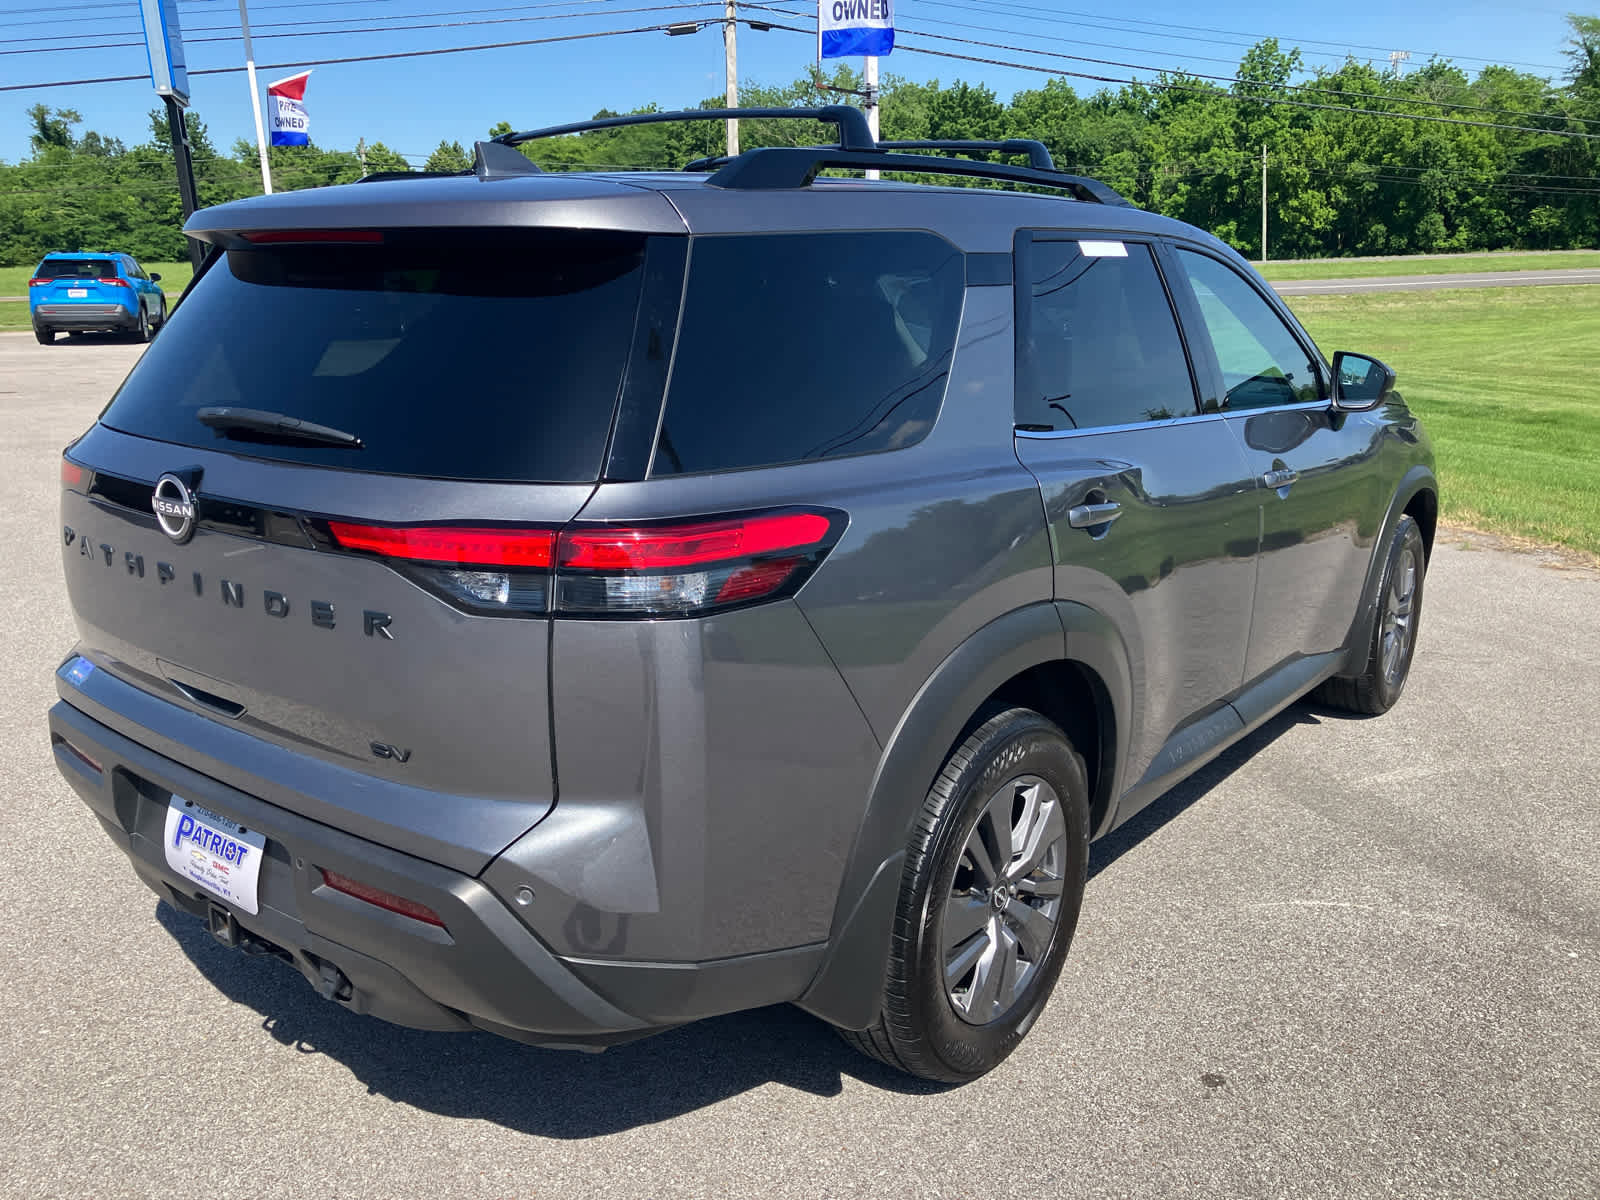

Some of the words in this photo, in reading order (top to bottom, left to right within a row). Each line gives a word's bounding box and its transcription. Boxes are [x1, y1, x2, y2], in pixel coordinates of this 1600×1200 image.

[832, 0, 889, 21] OWNED
[279, 100, 296, 112] PRE
[275, 117, 304, 128] OWNED
[152, 496, 191, 516] NISSAN
[64, 525, 394, 640] PATHFINDER
[370, 741, 411, 763] SV
